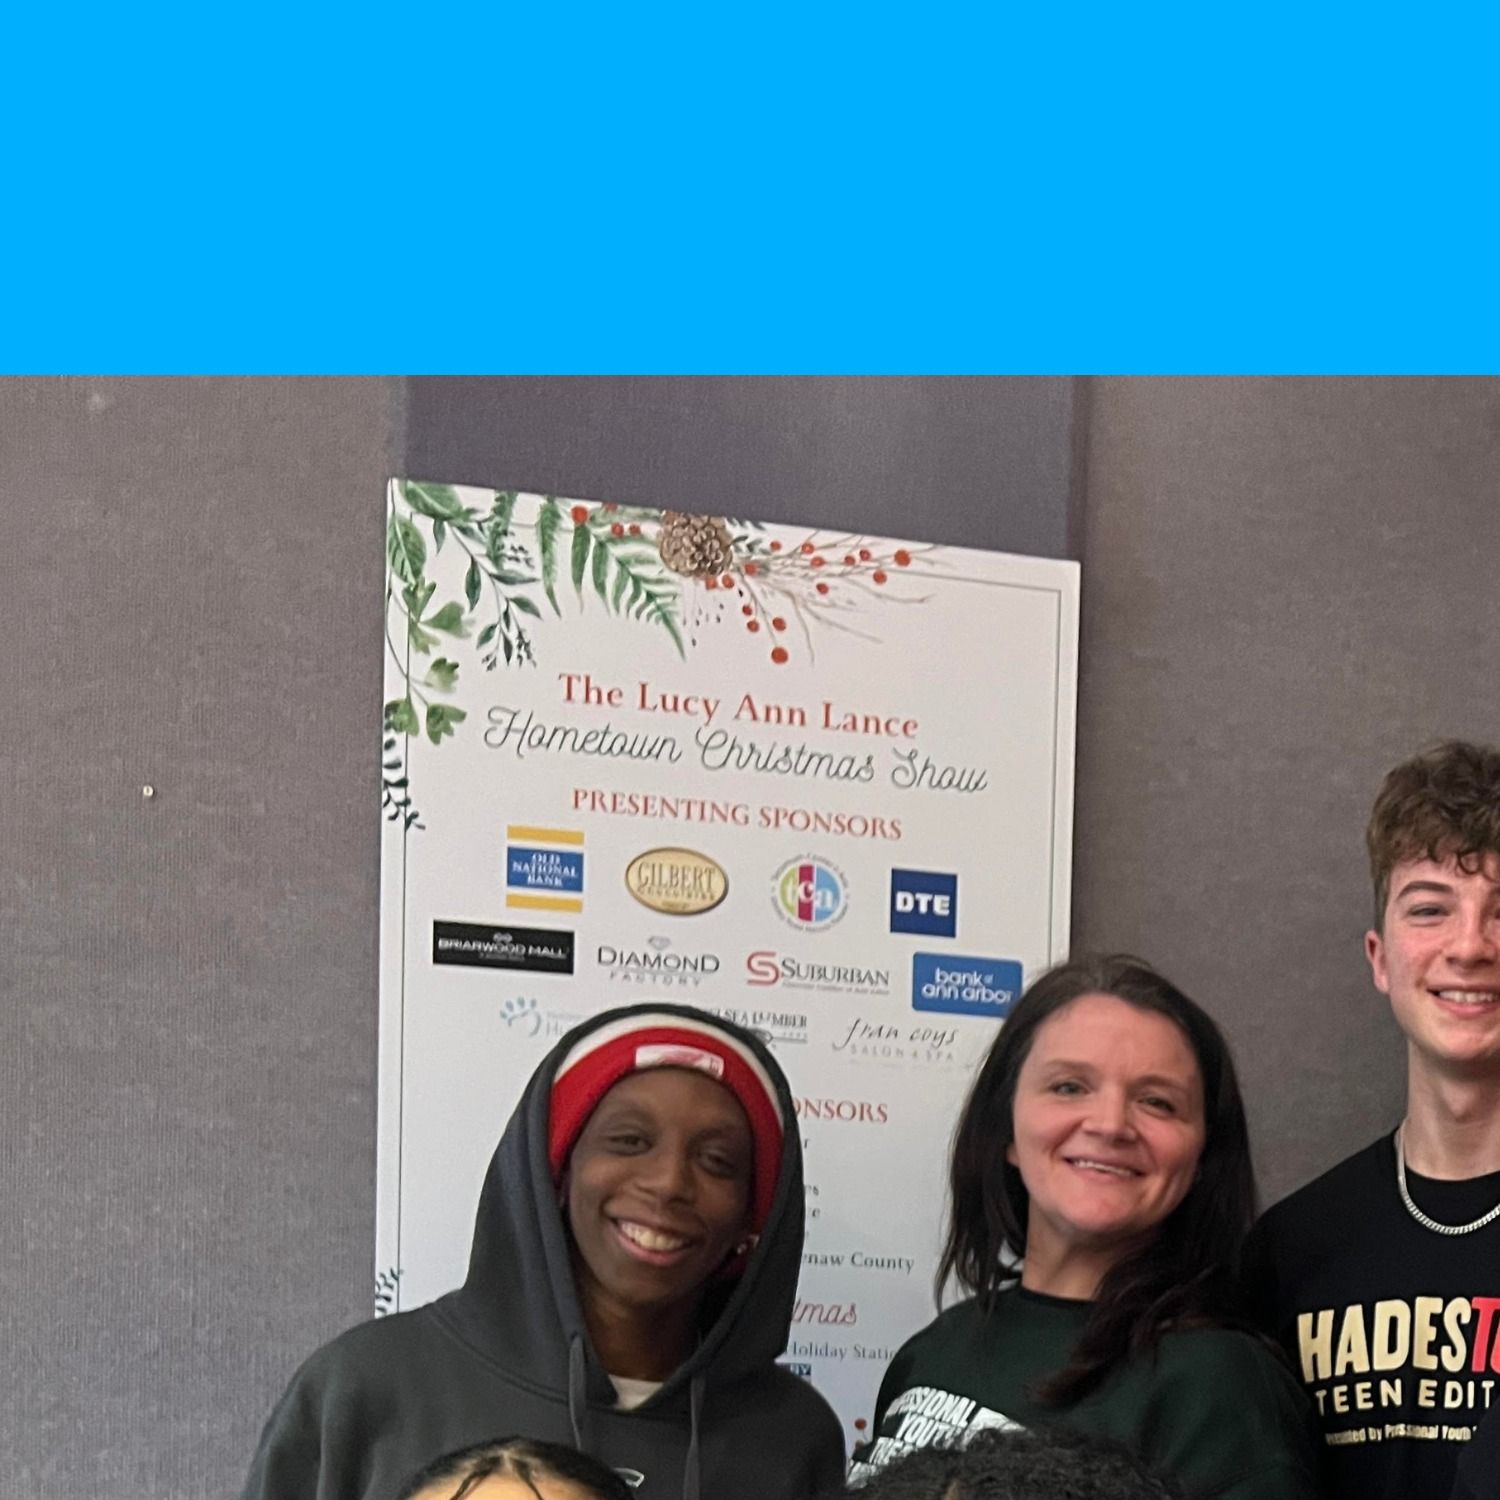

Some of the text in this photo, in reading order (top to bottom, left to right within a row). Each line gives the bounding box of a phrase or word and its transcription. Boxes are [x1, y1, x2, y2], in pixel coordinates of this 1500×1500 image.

[559, 673, 919, 739] The Lucy Ann Lance
[484, 706, 989, 793] Hometown Christmas Show
[572, 788, 902, 840] PRESENTING SPONSORS
[512, 860, 577, 878] NATIONAL
[531, 852, 561, 864] OLD
[527, 875, 563, 888] BANK
[637, 861, 716, 892] GILBERT
[896, 891, 950, 917] DTE
[438, 938, 526, 955] BRIARWOOD
[528, 944, 567, 959] MALL
[597, 946, 720, 974] DIAMOND
[935, 967, 982, 986] bank
[922, 984, 959, 1001] ann
[851, 1252, 914, 1273] County
[1316, 1378, 1402, 1416] TEEN
